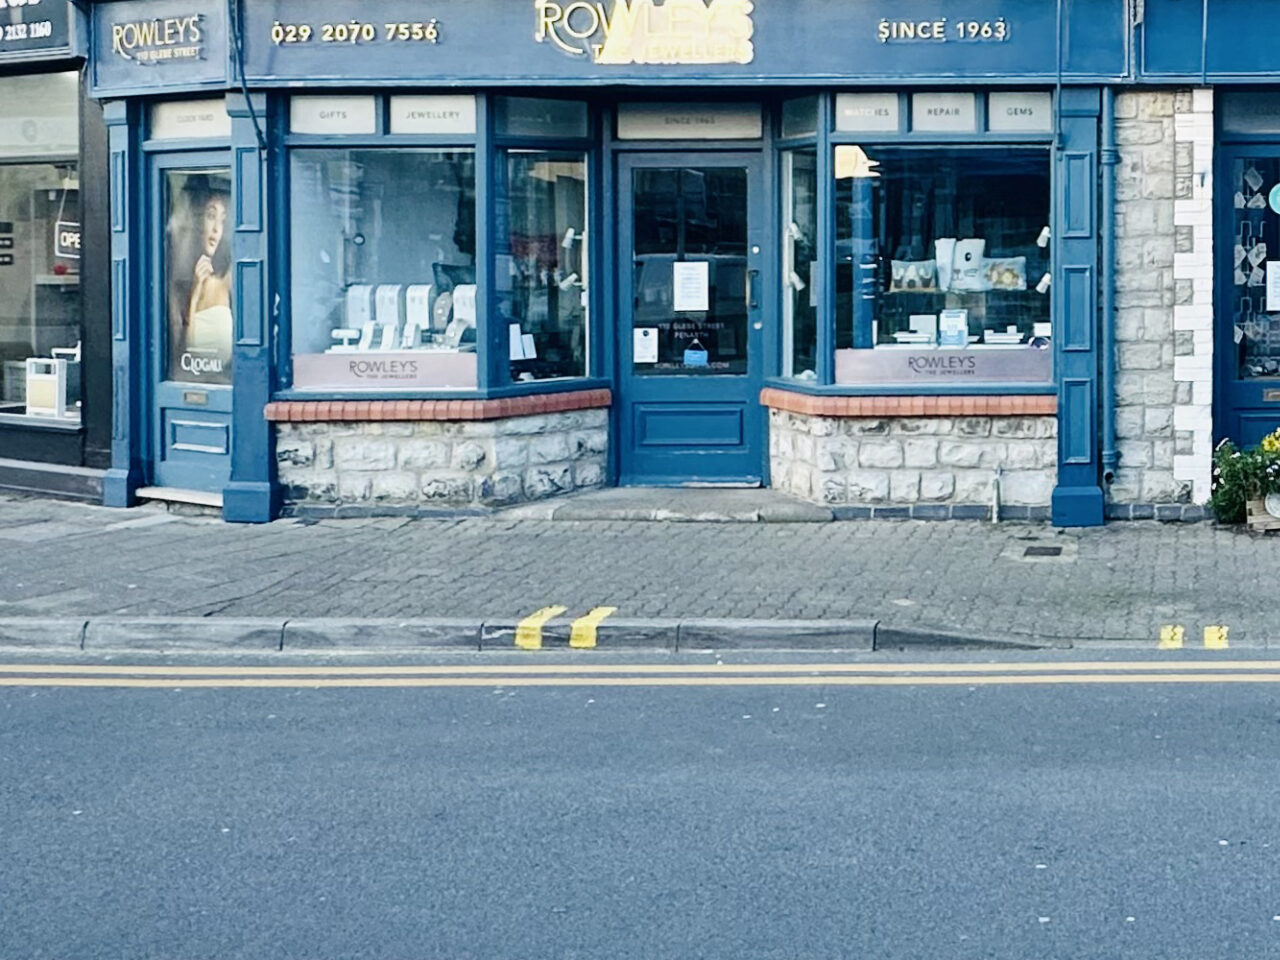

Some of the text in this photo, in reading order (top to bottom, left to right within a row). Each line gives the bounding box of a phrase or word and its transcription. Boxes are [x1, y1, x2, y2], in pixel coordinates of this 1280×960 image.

[271, 23, 438, 42] 029 2070 7556
[878, 21, 1006, 39] SINCE 1963
[174, 46, 200, 58] STREET
[319, 111, 347, 120] GIFTS
[405, 111, 461, 120] JEWELLERY
[927, 108, 960, 116] REPAIR
[1006, 107, 1034, 116] GEMS
[61, 232, 81, 249] OPE
[908, 356, 976, 374] ROWLEY'S
